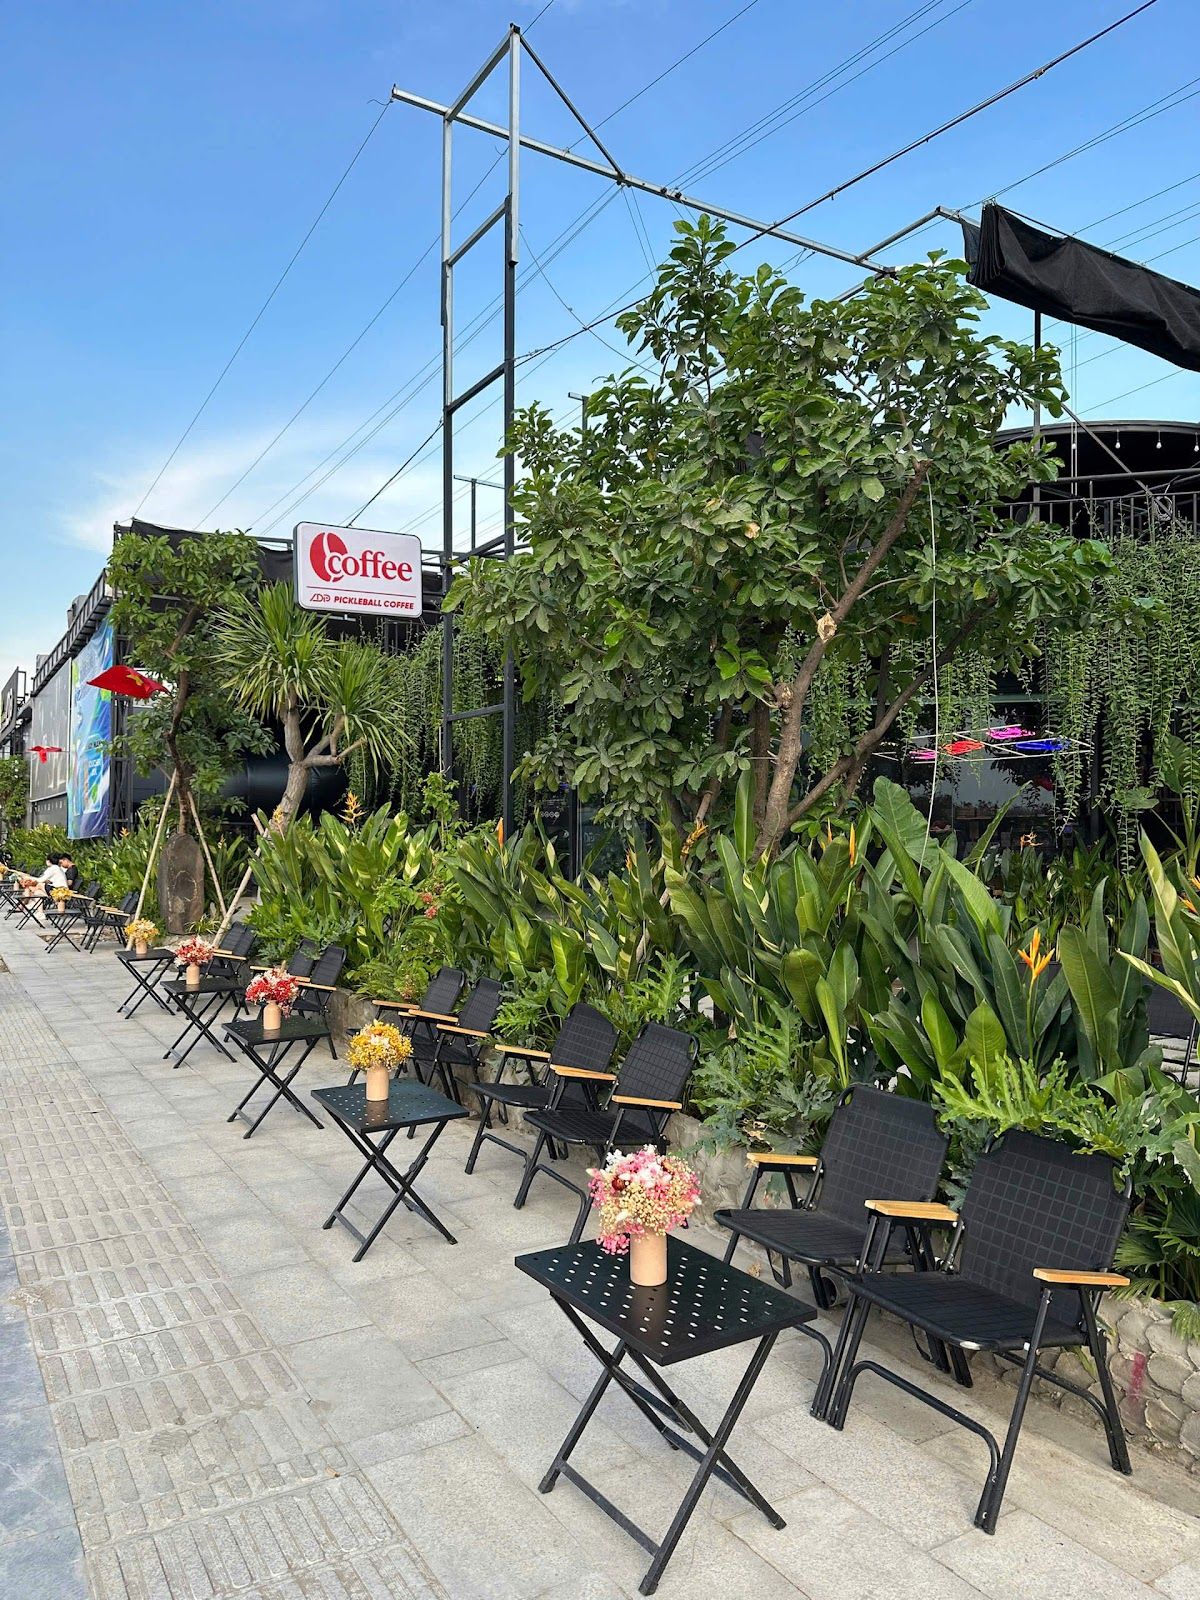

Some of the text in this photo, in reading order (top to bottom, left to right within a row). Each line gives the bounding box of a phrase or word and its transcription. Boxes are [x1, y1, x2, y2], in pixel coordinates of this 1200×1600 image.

[327, 550, 413, 582] coffee
[334, 595, 382, 607] PICKLEBALL
[383, 600, 415, 610] COFFEE
